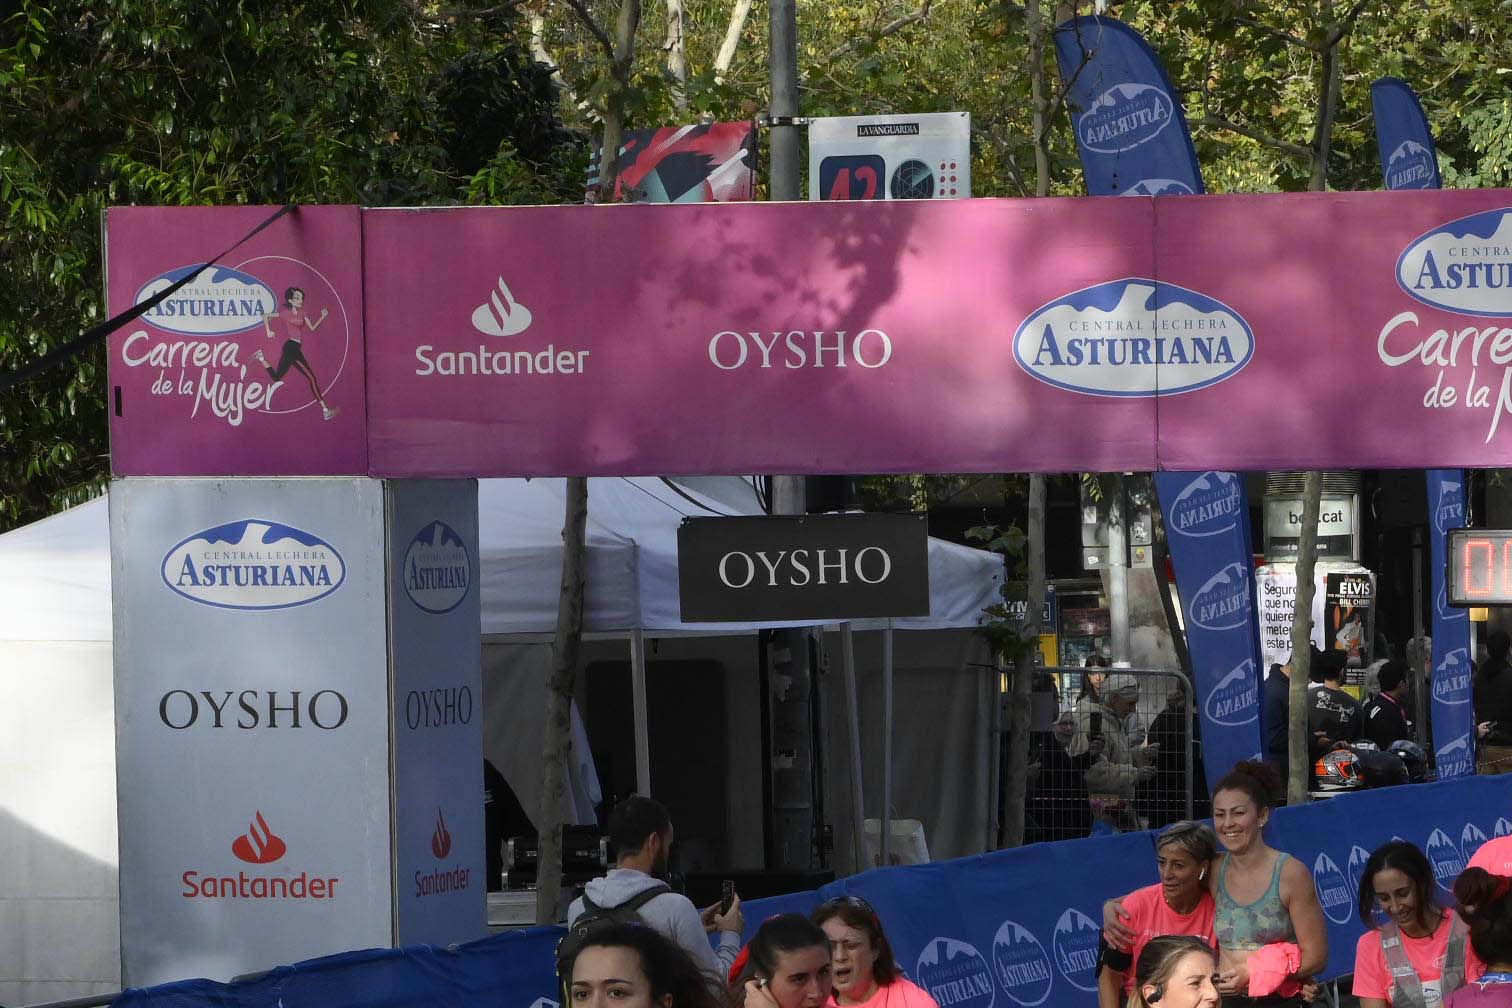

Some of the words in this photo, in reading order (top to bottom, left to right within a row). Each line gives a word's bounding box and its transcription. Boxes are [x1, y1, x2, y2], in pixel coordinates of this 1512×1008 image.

[145, 290, 266, 317] ASTURIANA
[173, 288, 211, 297] ENTRAL
[215, 288, 262, 296] LECHERA
[1068, 320, 1148, 332] CENTRAL
[1152, 319, 1228, 331] LECHERA
[121, 330, 241, 368] Carrera
[415, 344, 591, 376] Santander
[707, 329, 893, 370] OYSHO
[1032, 322, 1236, 367] ASTURIANA
[151, 368, 174, 396] de
[177, 368, 194, 396] la
[190, 364, 284, 427] Mujer
[1422, 369, 1460, 410] de
[1464, 369, 1490, 410] la
[176, 553, 333, 588] ASTURIANA
[203, 551, 262, 560] CENTRAL
[267, 551, 327, 560] LECHERA
[718, 546, 892, 589] OYSHO
[408, 558, 467, 592] ASTURIANA
[1339, 581, 1370, 595] ELVIS
[1267, 638, 1284, 649] este
[158, 689, 349, 730] OYSHO
[405, 685, 473, 731] OYSHO
[182, 870, 339, 899] Santander
[415, 866, 470, 898] Santander
[926, 972, 993, 1007] STURIANA
[999, 957, 1050, 989] ASTURIANA
